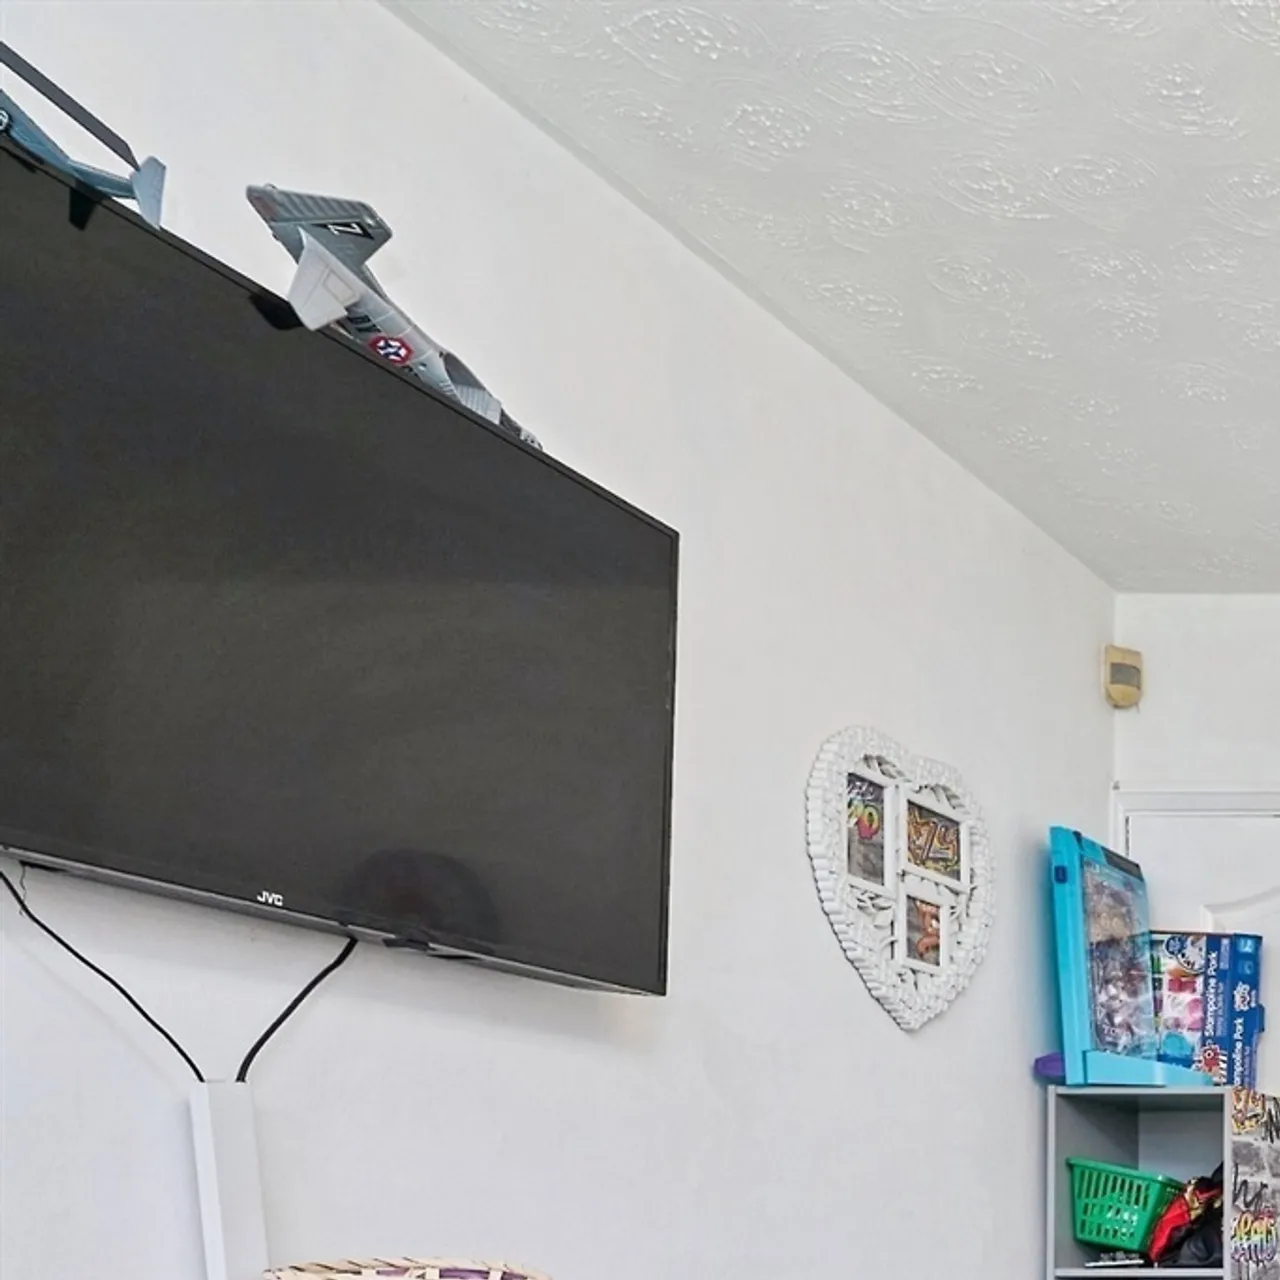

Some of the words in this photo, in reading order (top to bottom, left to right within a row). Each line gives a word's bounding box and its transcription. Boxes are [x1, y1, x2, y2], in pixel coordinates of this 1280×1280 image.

[256, 890, 284, 907] JVC
[1206, 950, 1218, 976] Park
[1233, 1017, 1245, 1039] Park
